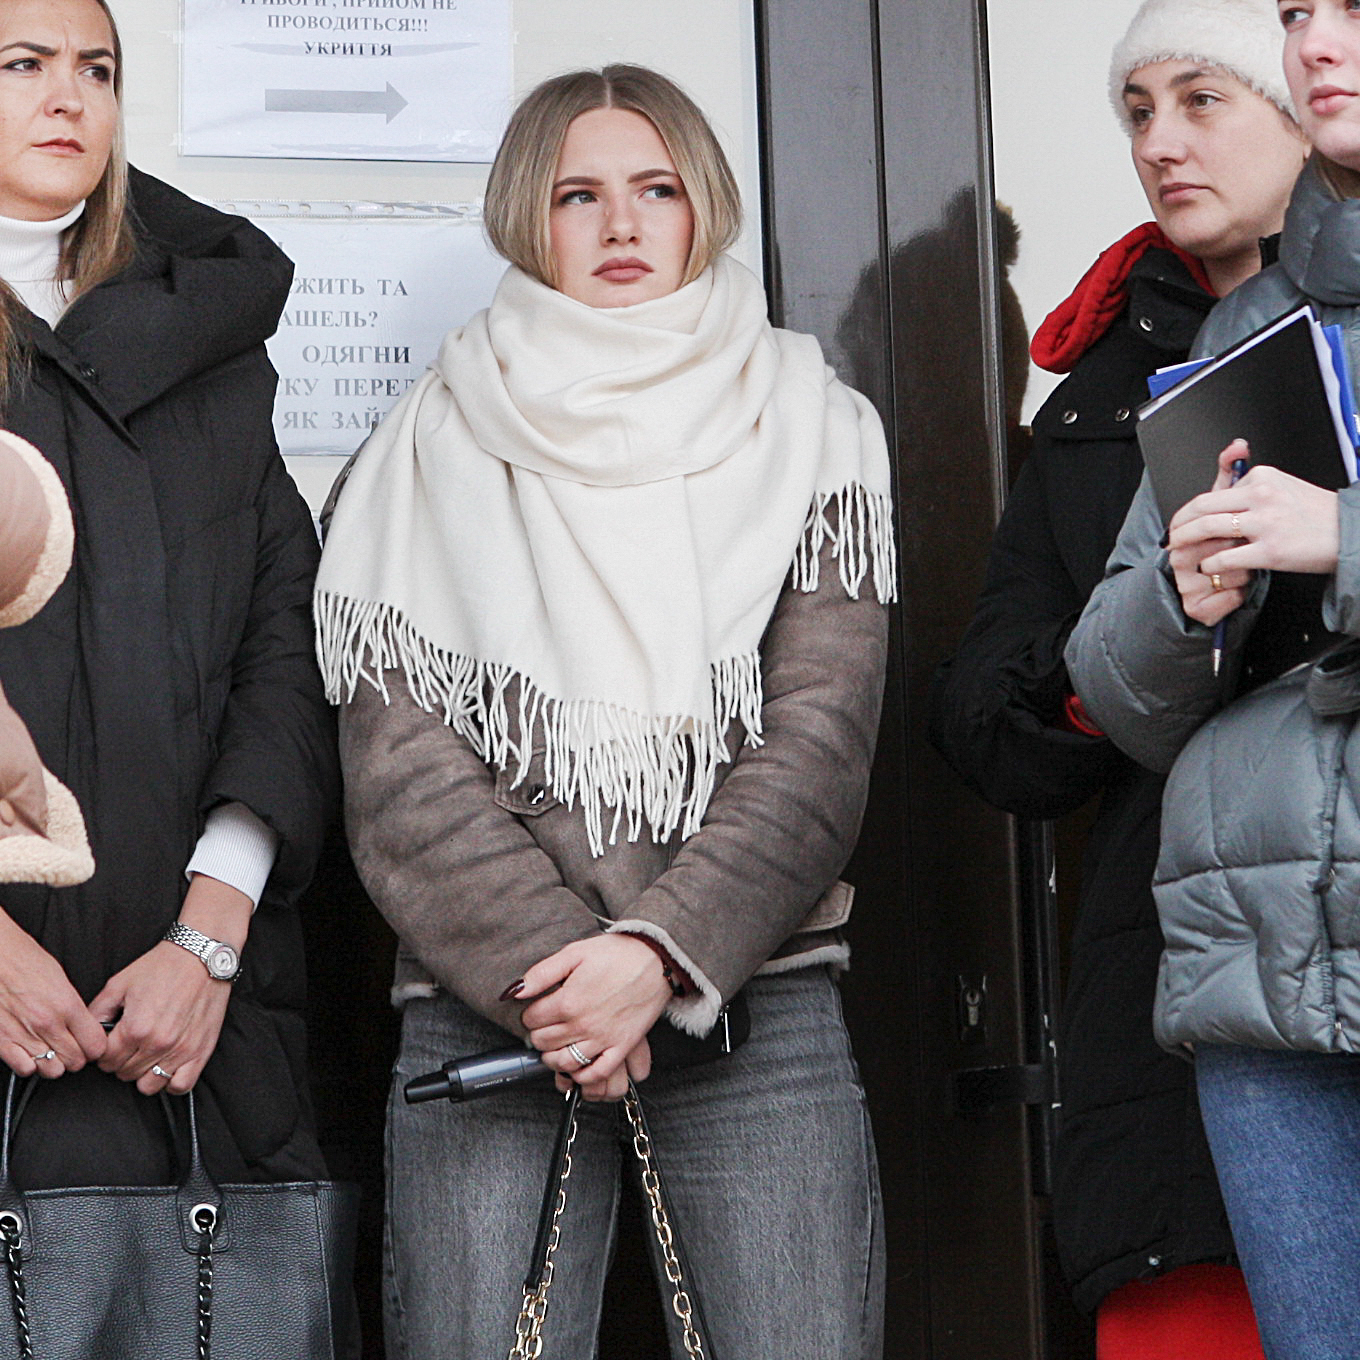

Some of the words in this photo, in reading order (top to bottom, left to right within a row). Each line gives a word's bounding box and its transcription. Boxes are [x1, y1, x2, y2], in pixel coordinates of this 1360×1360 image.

[267, 14, 428, 33] ПРОВОДИТЬСЯ!!!
[304, 41, 393, 57] УКРИТТЯ
[290, 277, 365, 295] ЖИТЬ
[376, 279, 409, 297] ТА
[302, 345, 413, 367] ОДЯГНИ
[283, 411, 319, 429] ЯК
[331, 406, 389, 429] ЗАЙ
